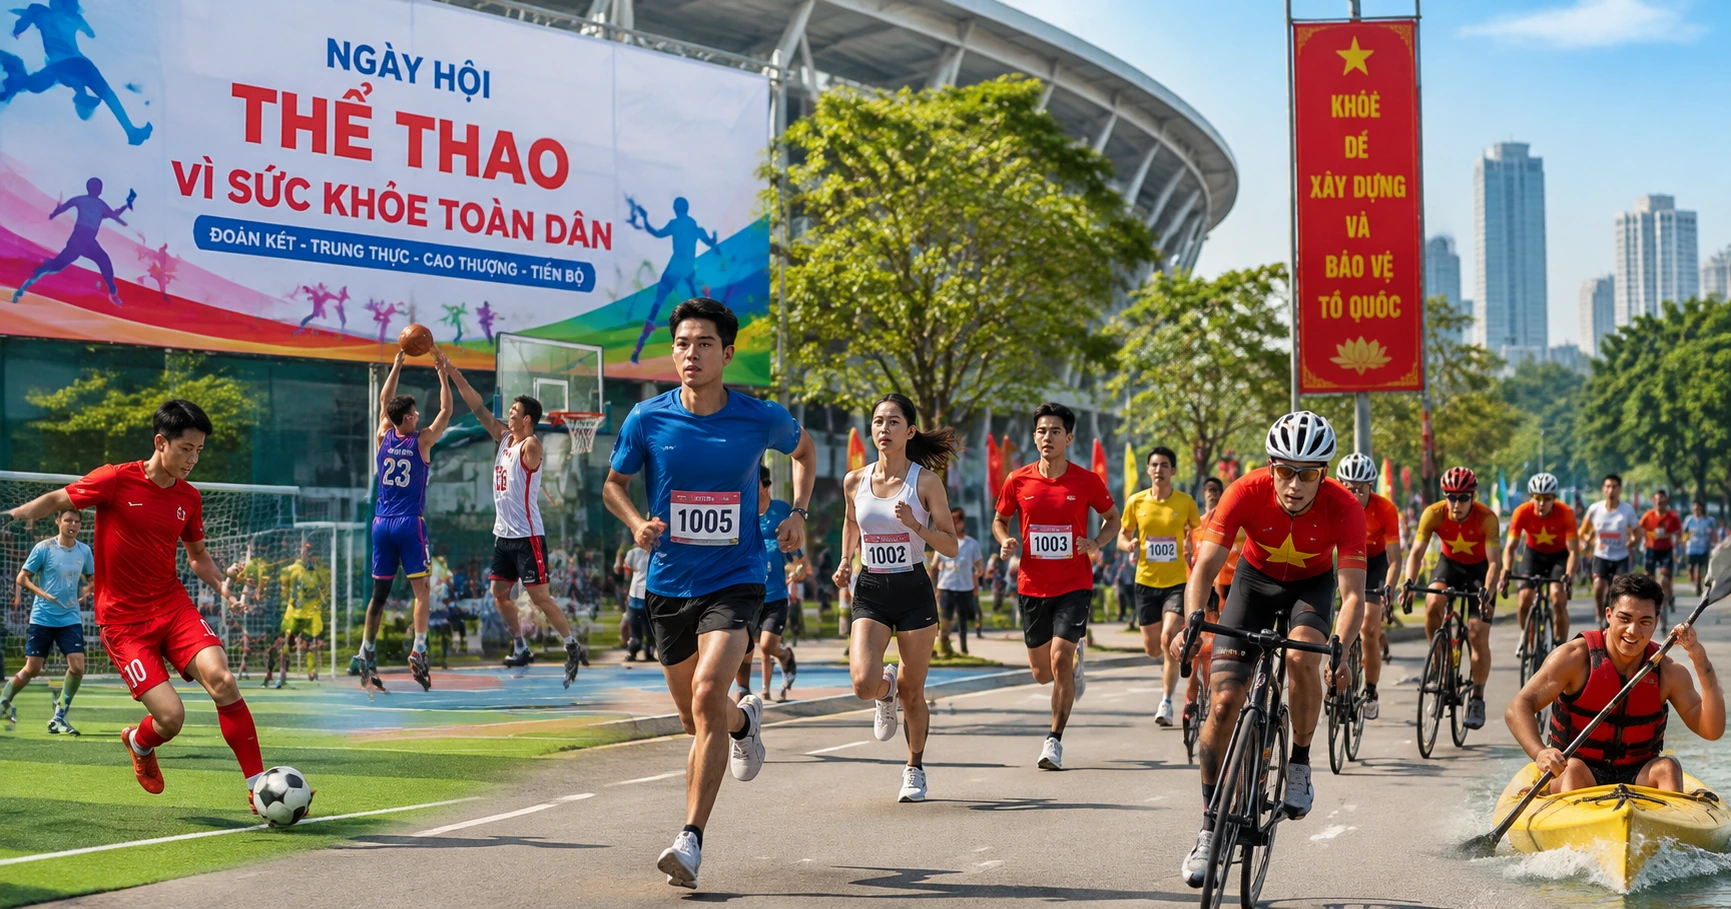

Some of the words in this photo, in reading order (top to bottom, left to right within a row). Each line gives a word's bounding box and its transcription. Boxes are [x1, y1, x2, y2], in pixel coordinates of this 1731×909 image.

[327, 37, 423, 84] NGÀY
[434, 59, 490, 103] HỘI
[231, 82, 373, 162] THỂ
[396, 110, 569, 190] THAO
[171, 155, 214, 200] VÌ
[227, 164, 311, 212] SỨC
[323, 180, 428, 228] KHỎE
[438, 197, 534, 242] TOÀN
[545, 209, 612, 251] DÂN
[1310, 170, 1347, 199] XÂY
[1353, 172, 1406, 204] DỰNG
[310, 239, 365, 259] TRUNG
[368, 245, 410, 267] THỰC
[422, 252, 455, 269] CAO
[458, 256, 518, 278] THƯỢNG
[382, 457, 412, 488] 23
[678, 508, 733, 534] 1005
[1034, 535, 1068, 552] 1003
[1149, 543, 1175, 557] 1002
[124, 658, 147, 689] 10
